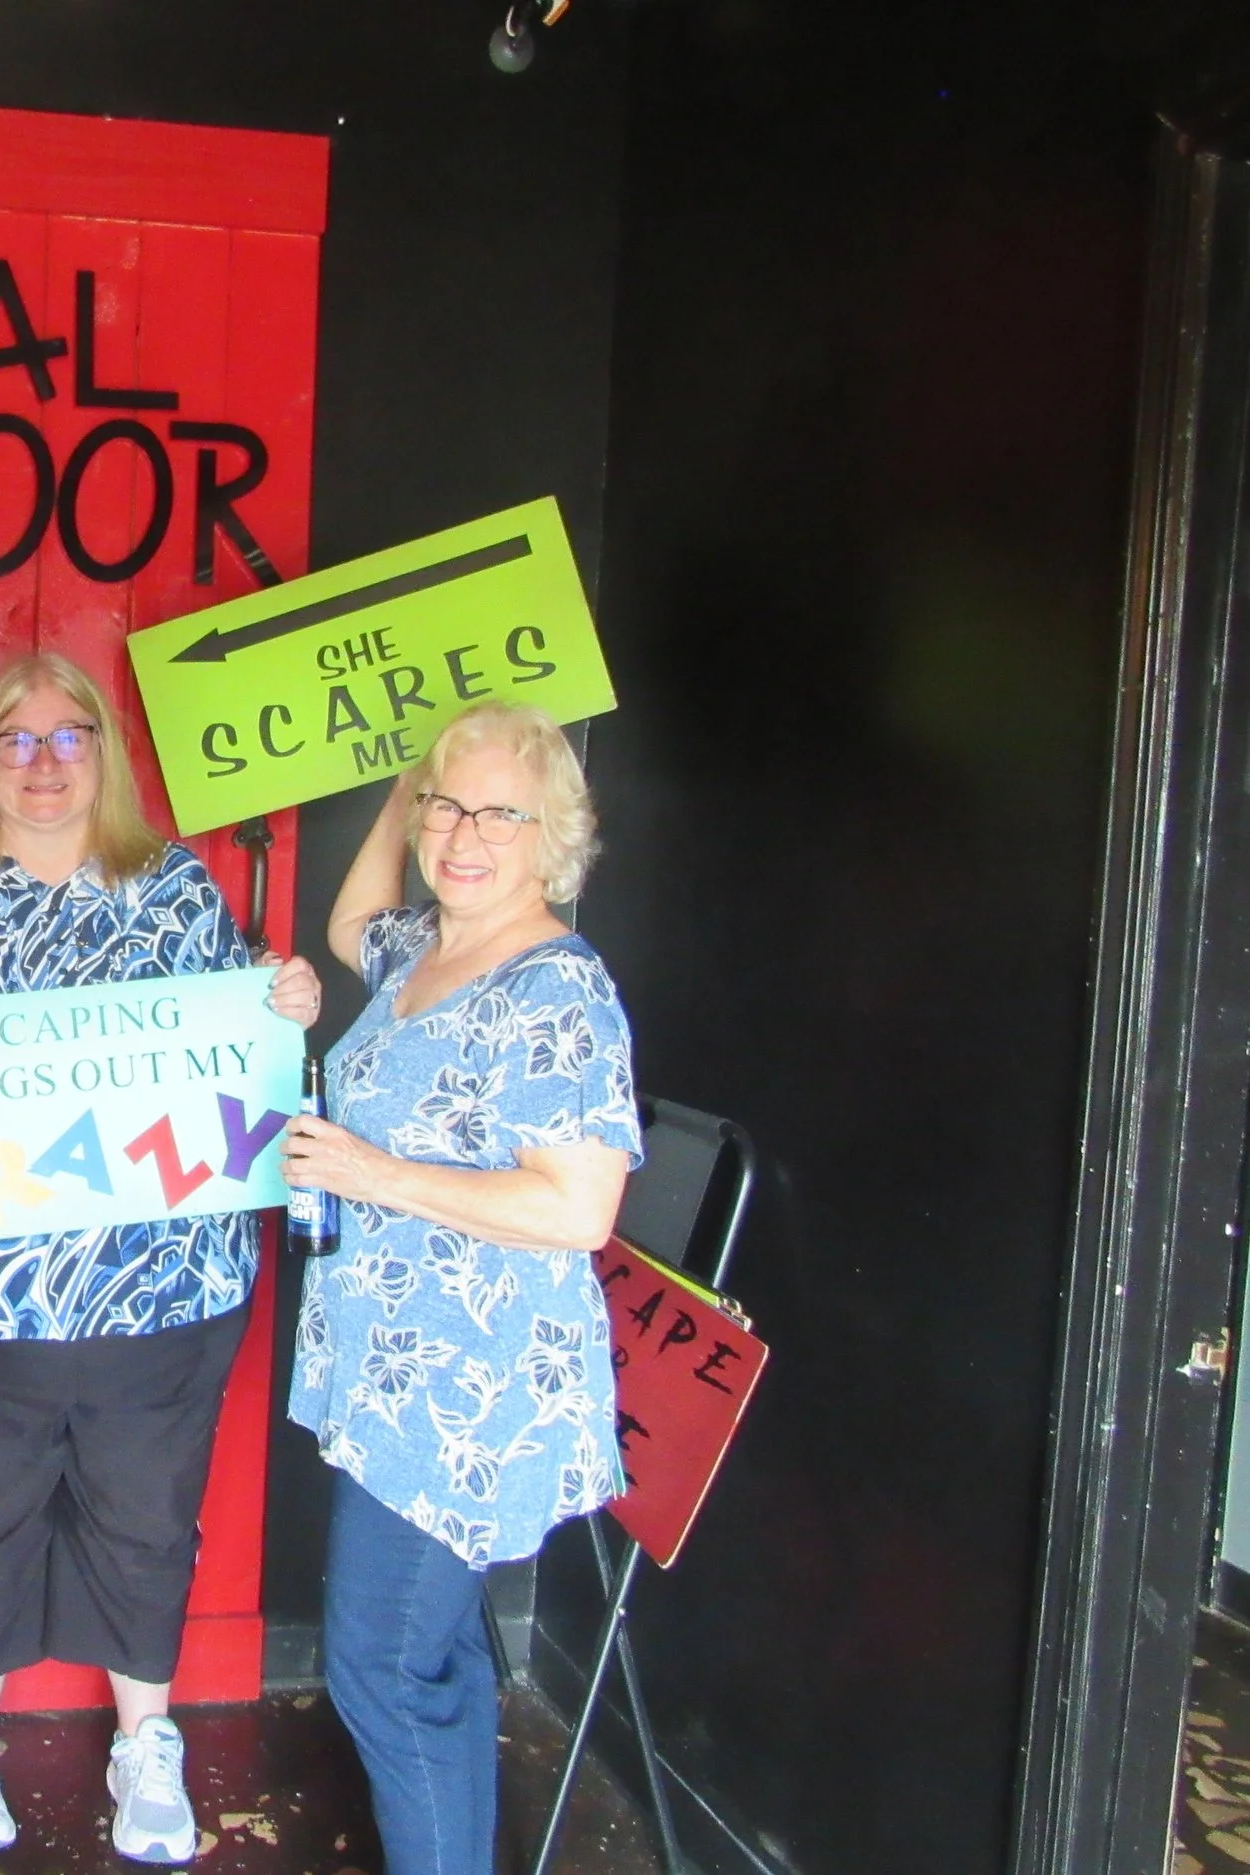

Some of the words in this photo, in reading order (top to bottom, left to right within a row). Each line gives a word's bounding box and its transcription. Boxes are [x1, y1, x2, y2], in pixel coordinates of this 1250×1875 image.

[316, 626, 402, 681] SHE
[200, 625, 557, 779] SCARES
[351, 728, 421, 775] ME
[71, 1051, 168, 1093] OUT
[185, 1041, 256, 1082] MY
[289, 1189, 314, 1206] UD
